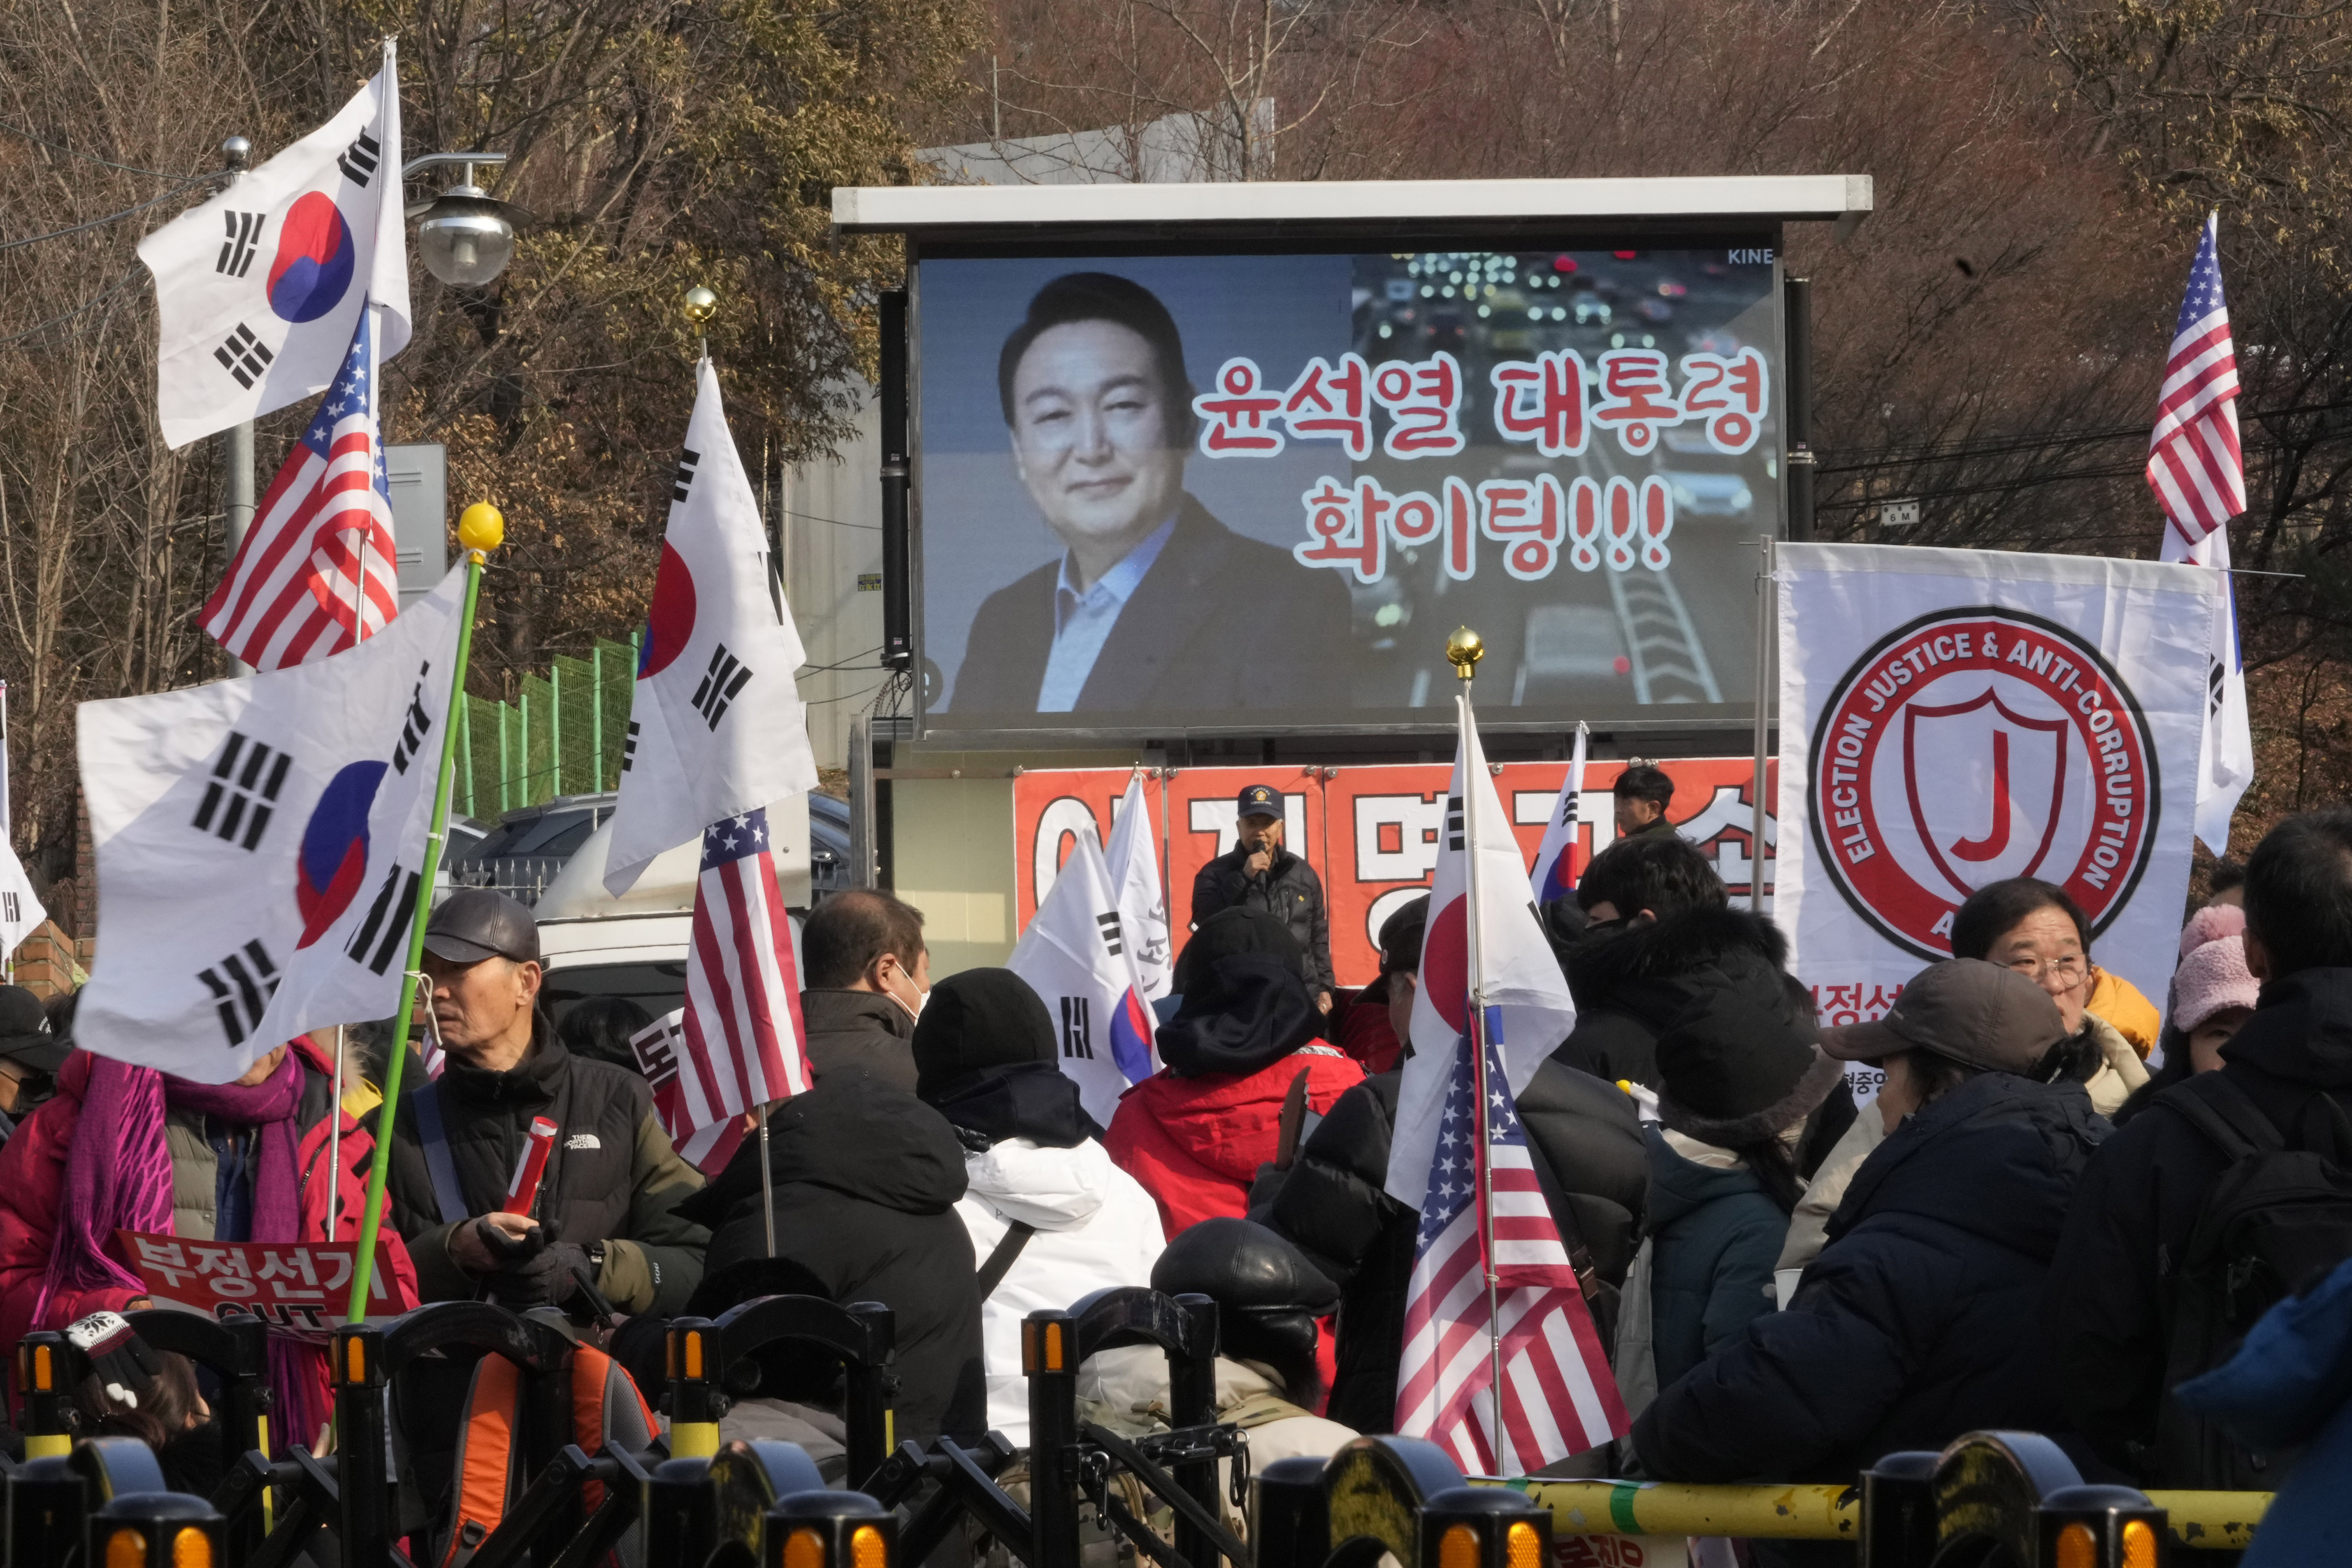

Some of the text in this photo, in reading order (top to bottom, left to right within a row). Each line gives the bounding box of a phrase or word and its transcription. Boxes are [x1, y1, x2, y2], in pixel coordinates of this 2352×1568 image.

[1192, 347, 1768, 460] 윤석열 대통령
[1294, 473, 1674, 583] 화이팅!!!
[1832, 631, 2133, 891] ELECTION JUSTICE & ANTI-CORRUPTION
